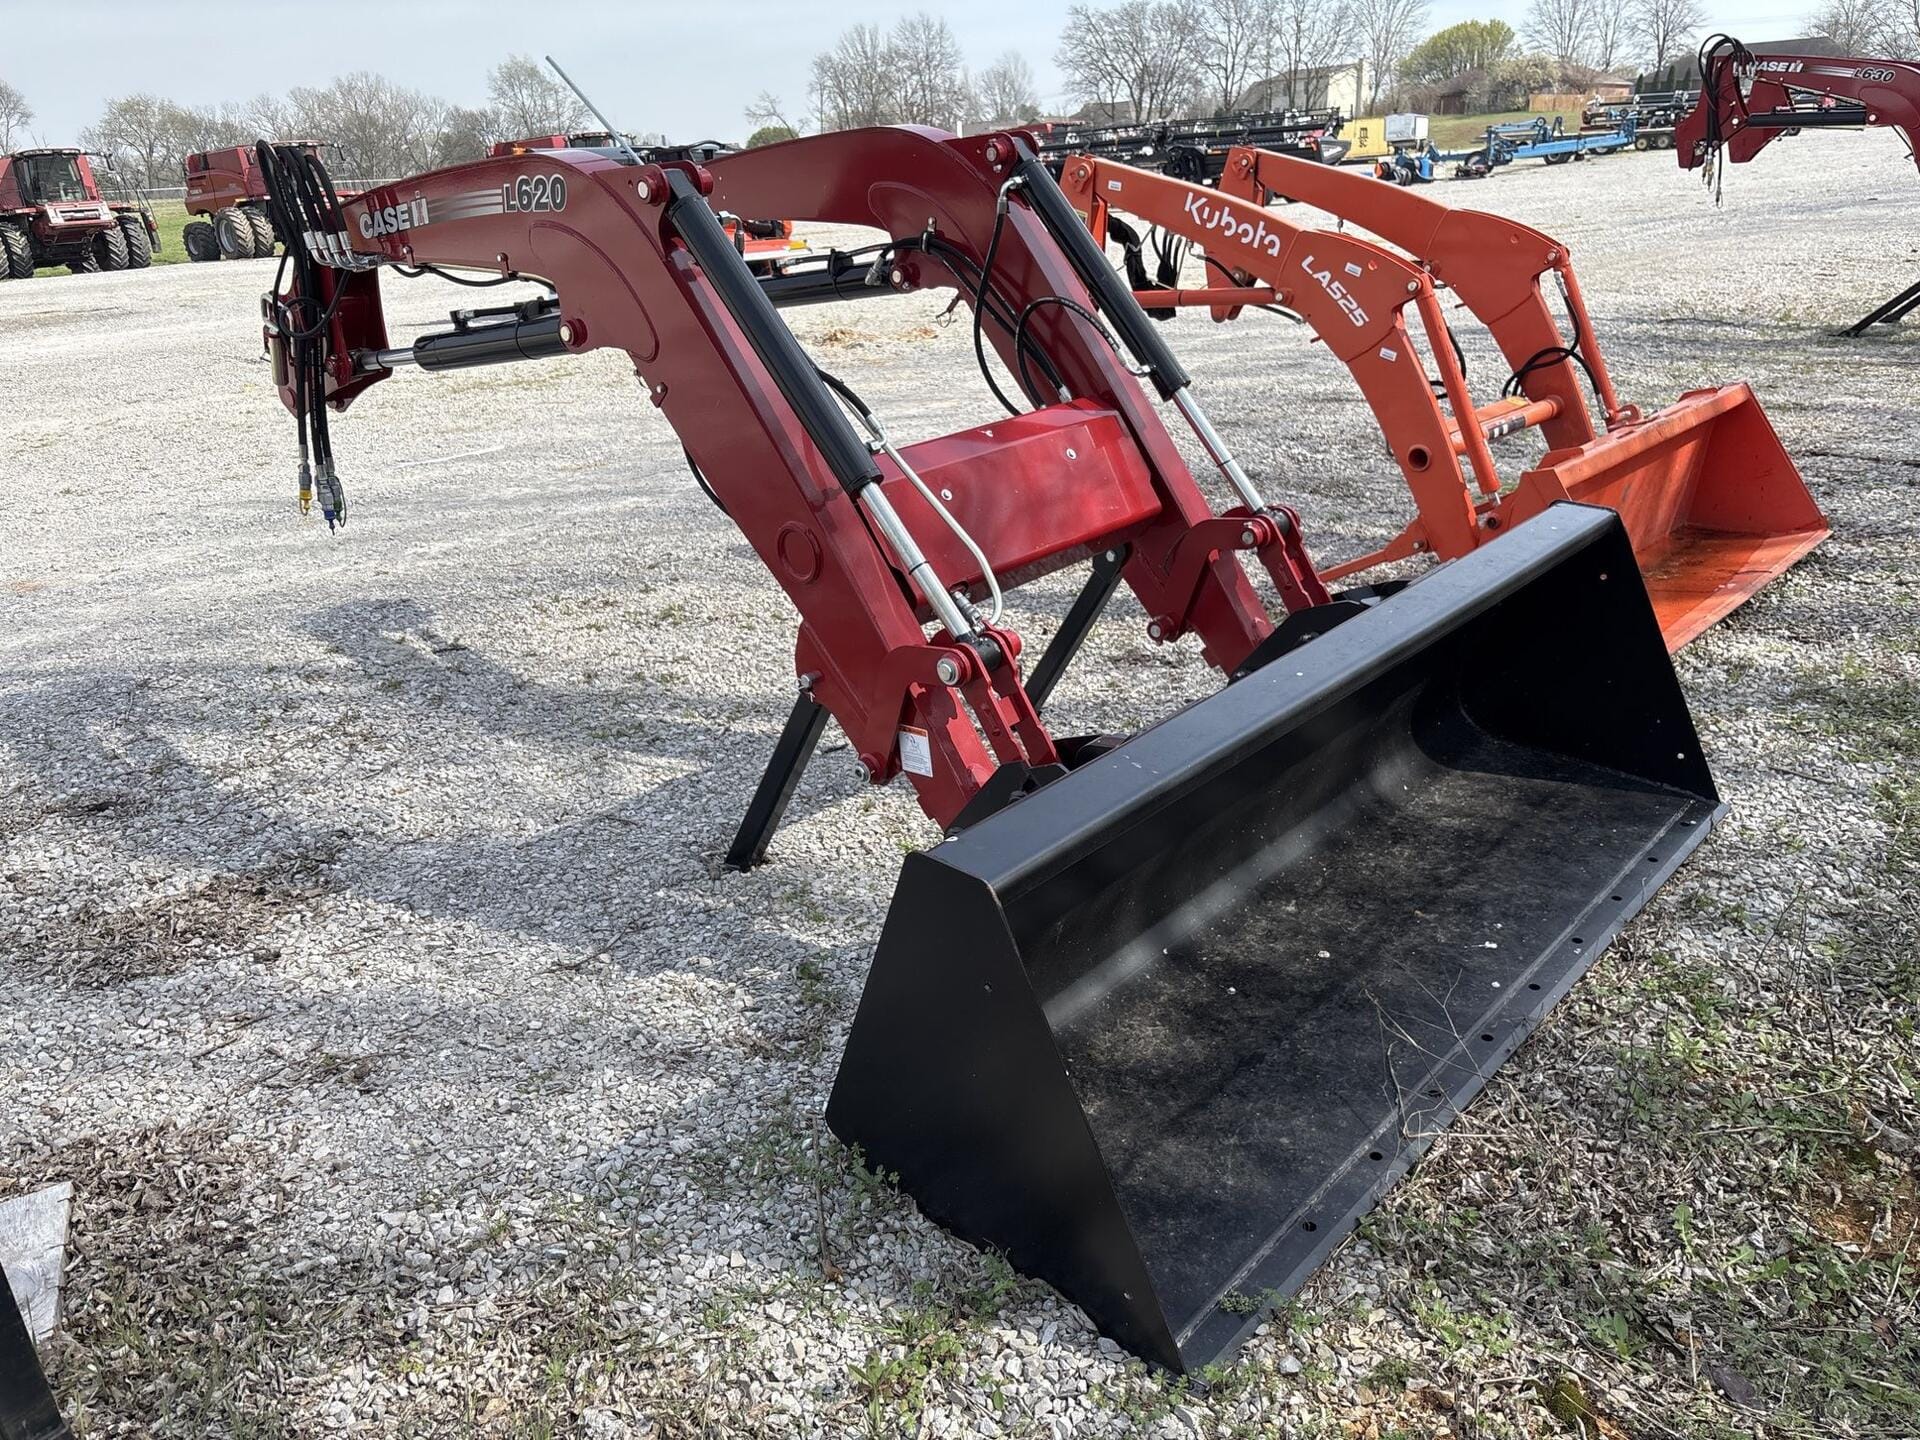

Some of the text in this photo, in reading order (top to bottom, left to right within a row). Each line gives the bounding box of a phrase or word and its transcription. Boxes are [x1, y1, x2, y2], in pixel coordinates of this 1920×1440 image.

[1853, 67, 1895, 82] L630
[359, 203, 411, 239] CASE
[503, 173, 567, 213] L620
[1184, 192, 1281, 257] Kubota
[1301, 255, 1370, 327] LA525
